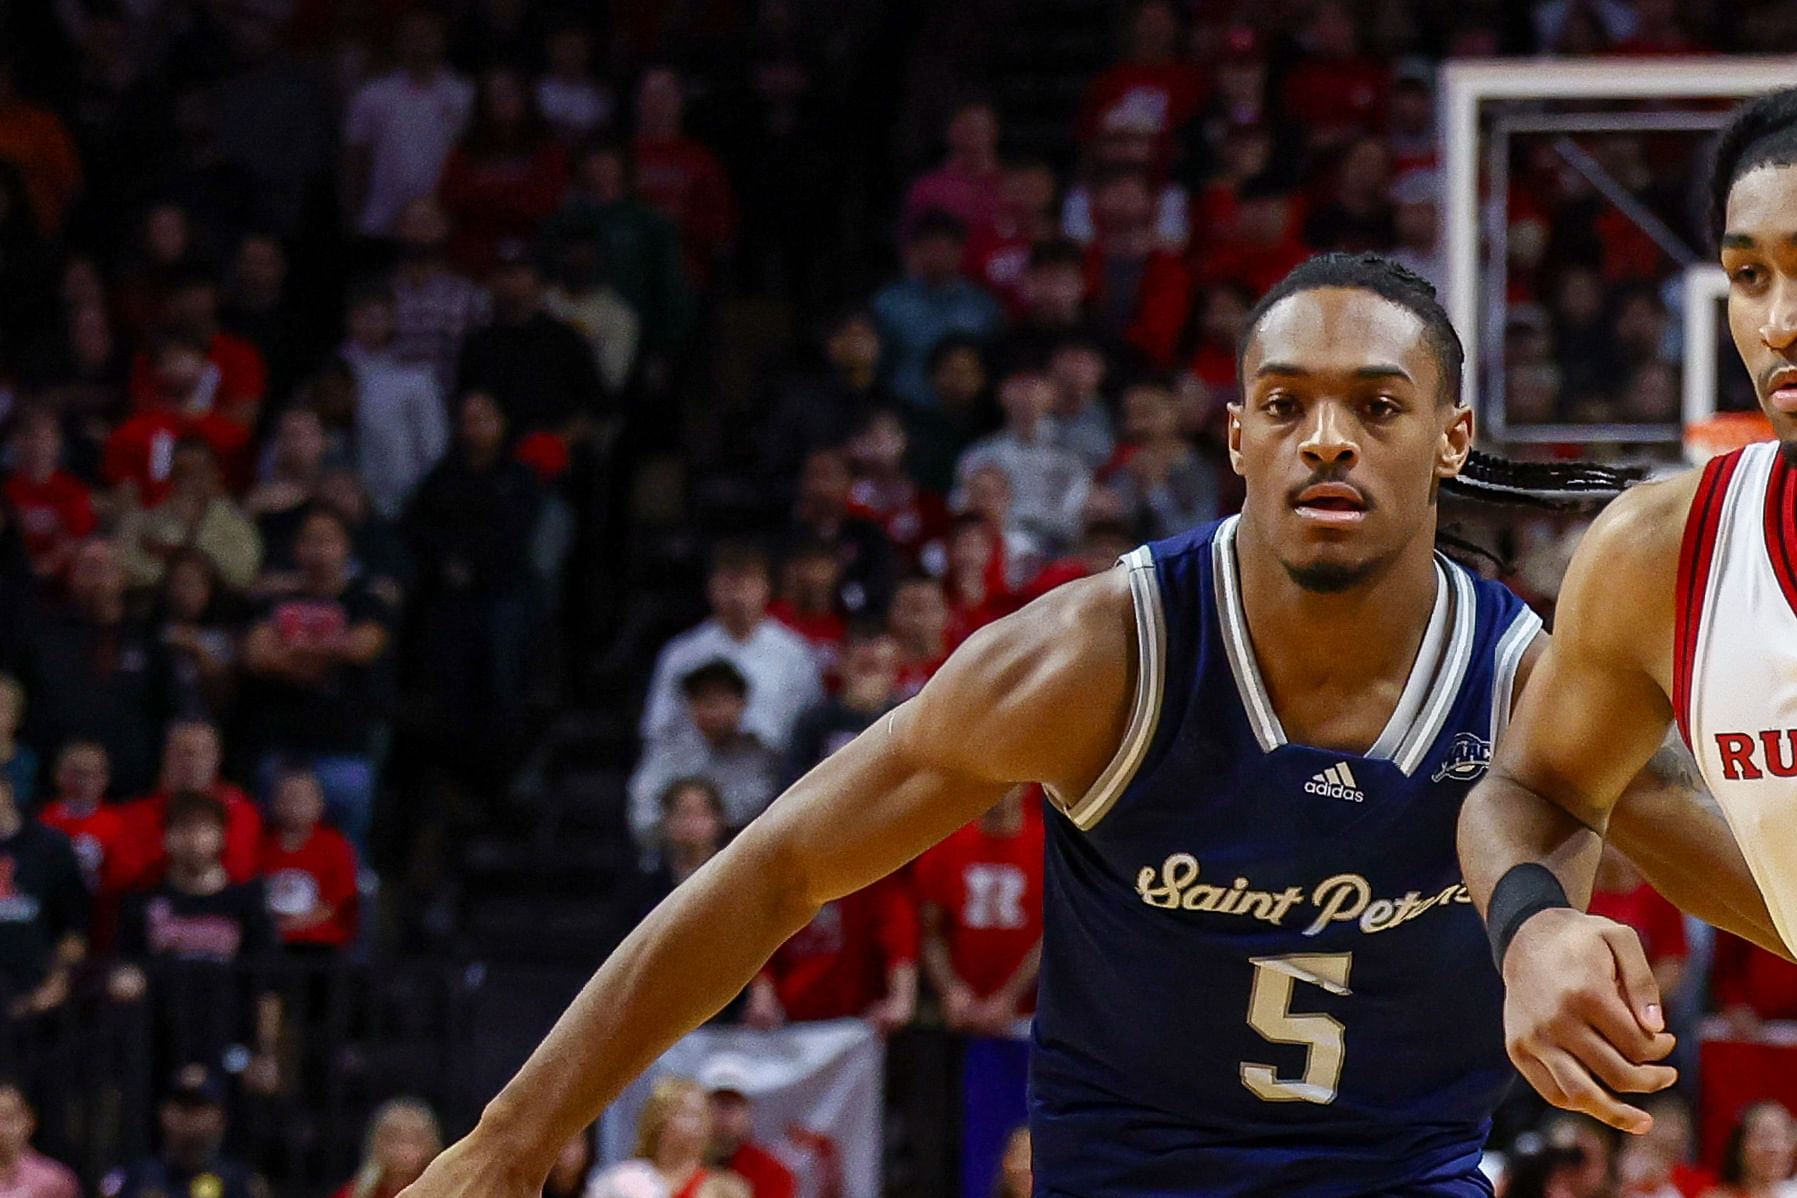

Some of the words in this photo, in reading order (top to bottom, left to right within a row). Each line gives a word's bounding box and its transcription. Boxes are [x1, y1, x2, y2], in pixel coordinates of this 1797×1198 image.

[1304, 781, 1364, 803] adidas
[1134, 852, 1304, 926] Saint
[1240, 951, 1353, 1105] 5
